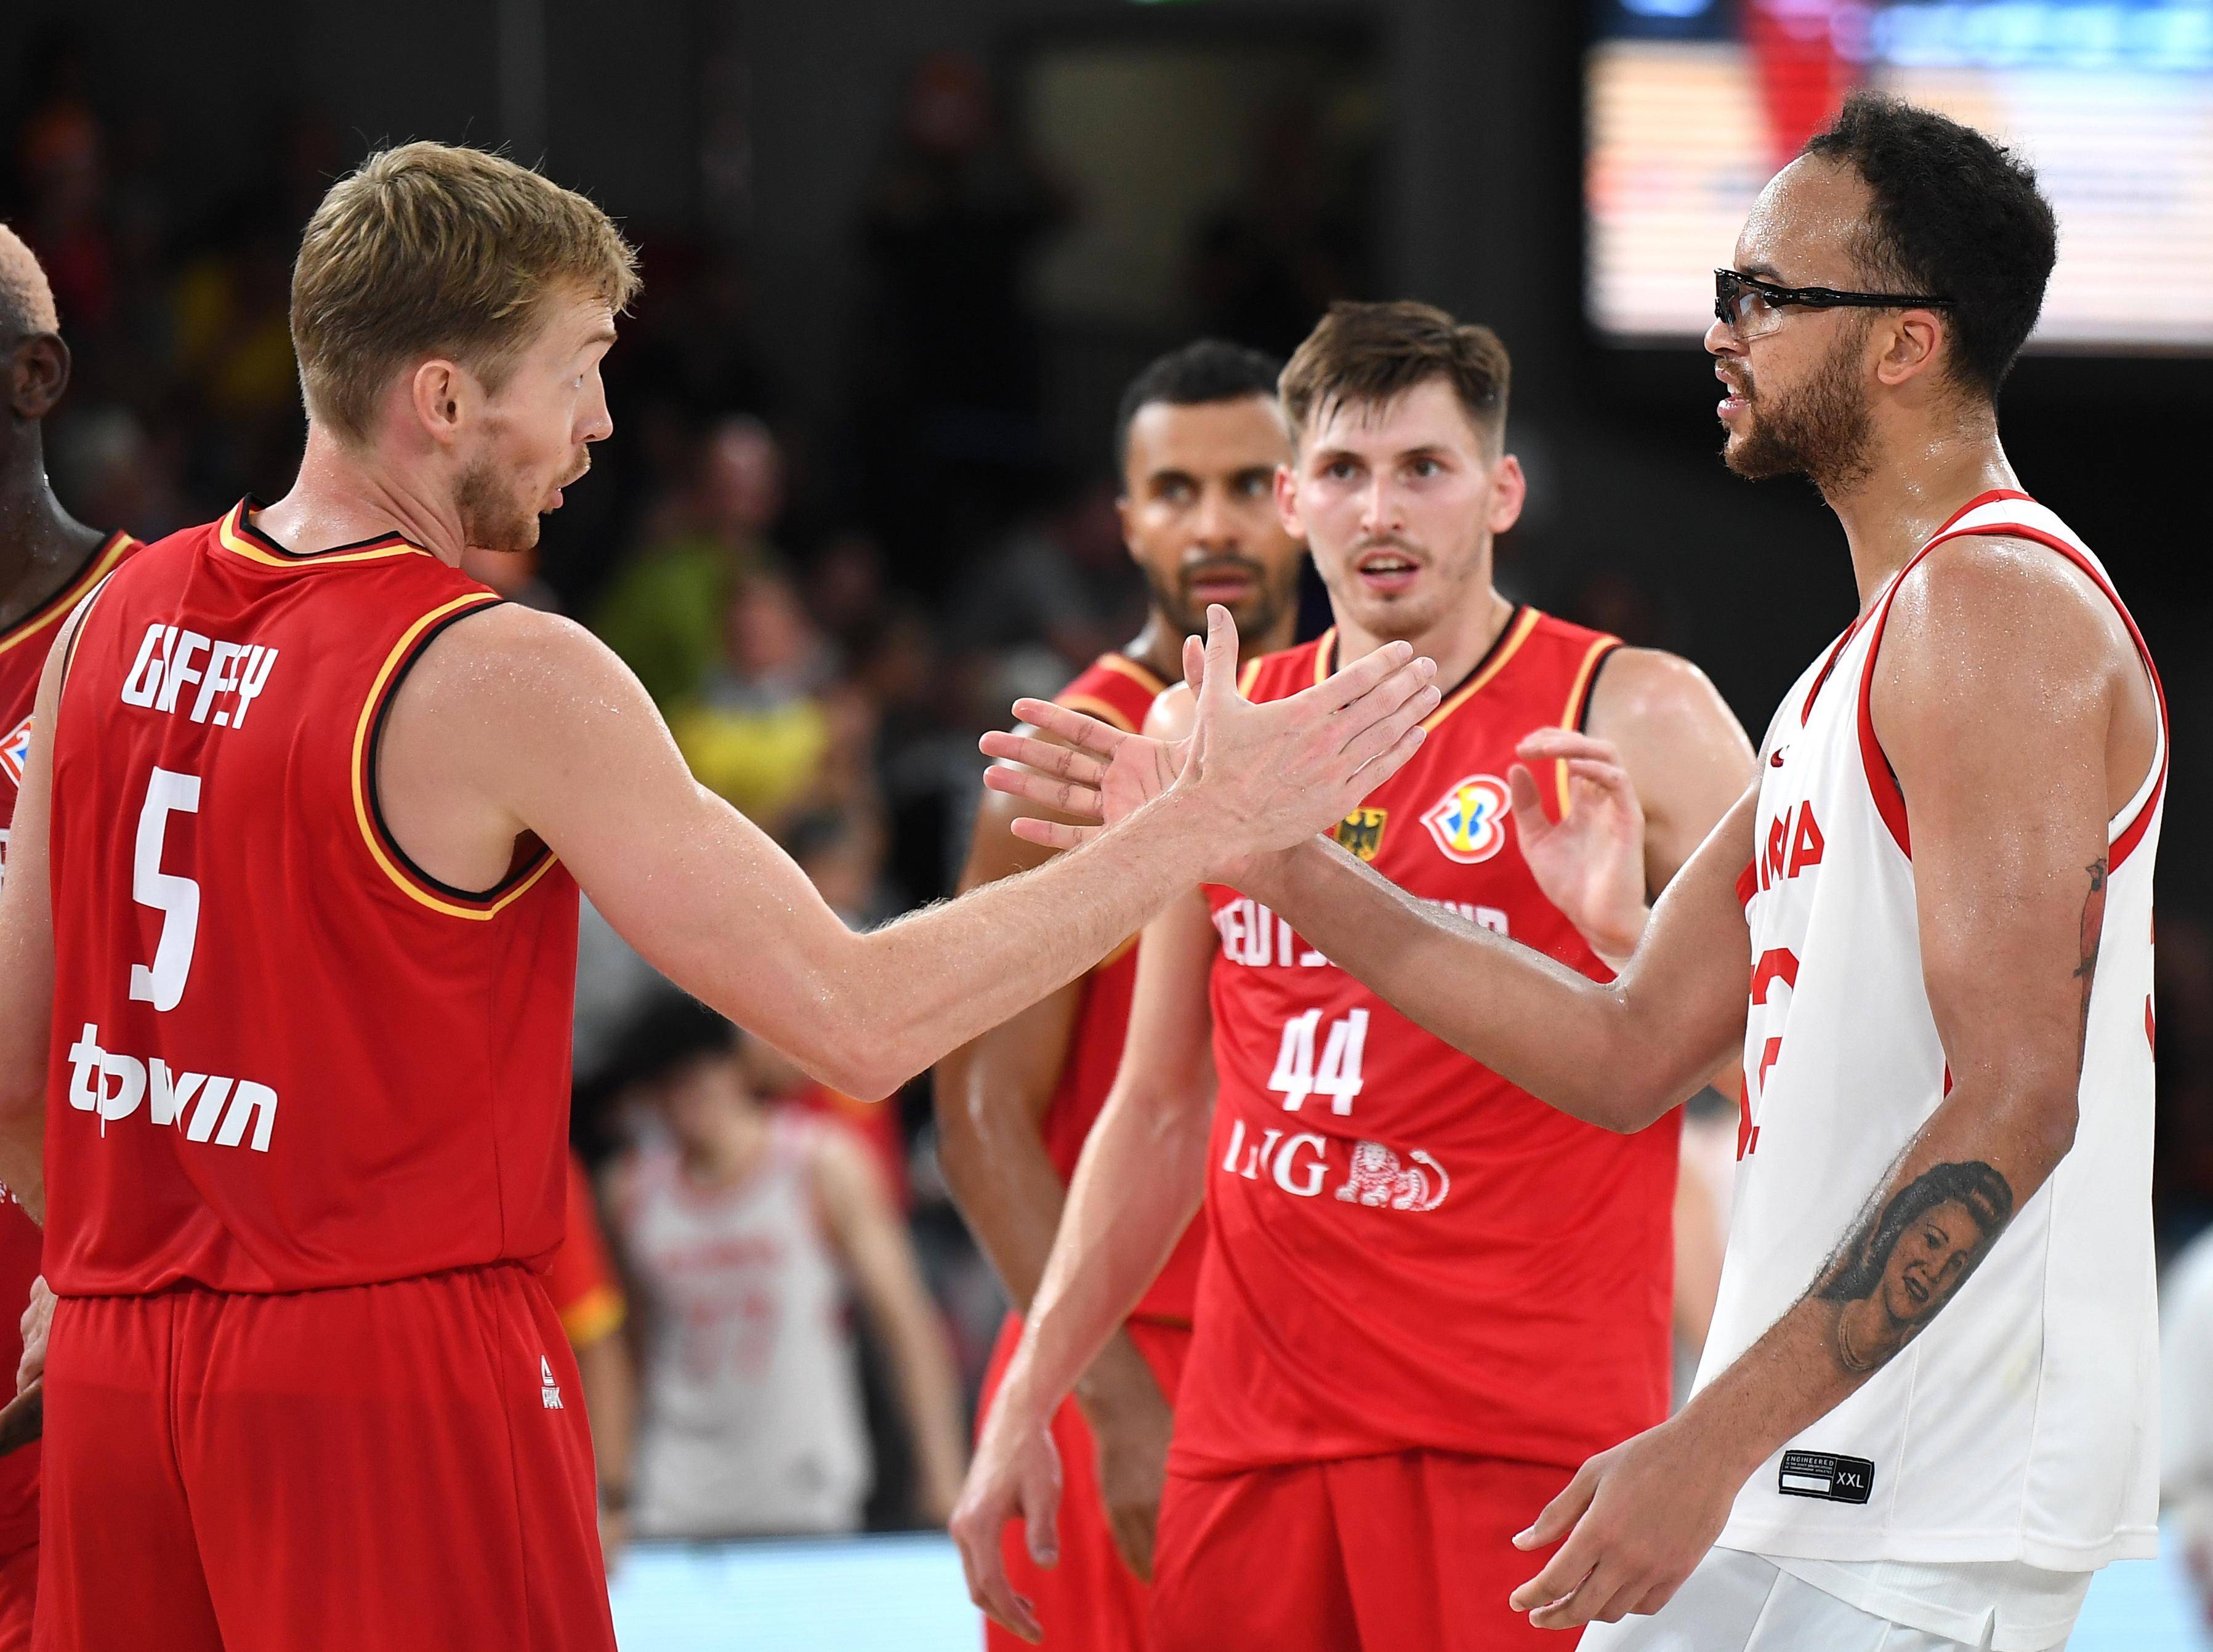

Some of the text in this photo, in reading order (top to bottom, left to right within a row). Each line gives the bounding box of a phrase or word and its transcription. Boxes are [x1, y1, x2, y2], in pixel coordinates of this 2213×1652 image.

[121, 623, 279, 730] GIFFEY
[129, 766, 201, 1012] 5
[1268, 1007, 1371, 1116] 44
[1786, 1456, 1834, 1467] ENGINEERED
[1836, 1471, 1864, 1489] XXL
